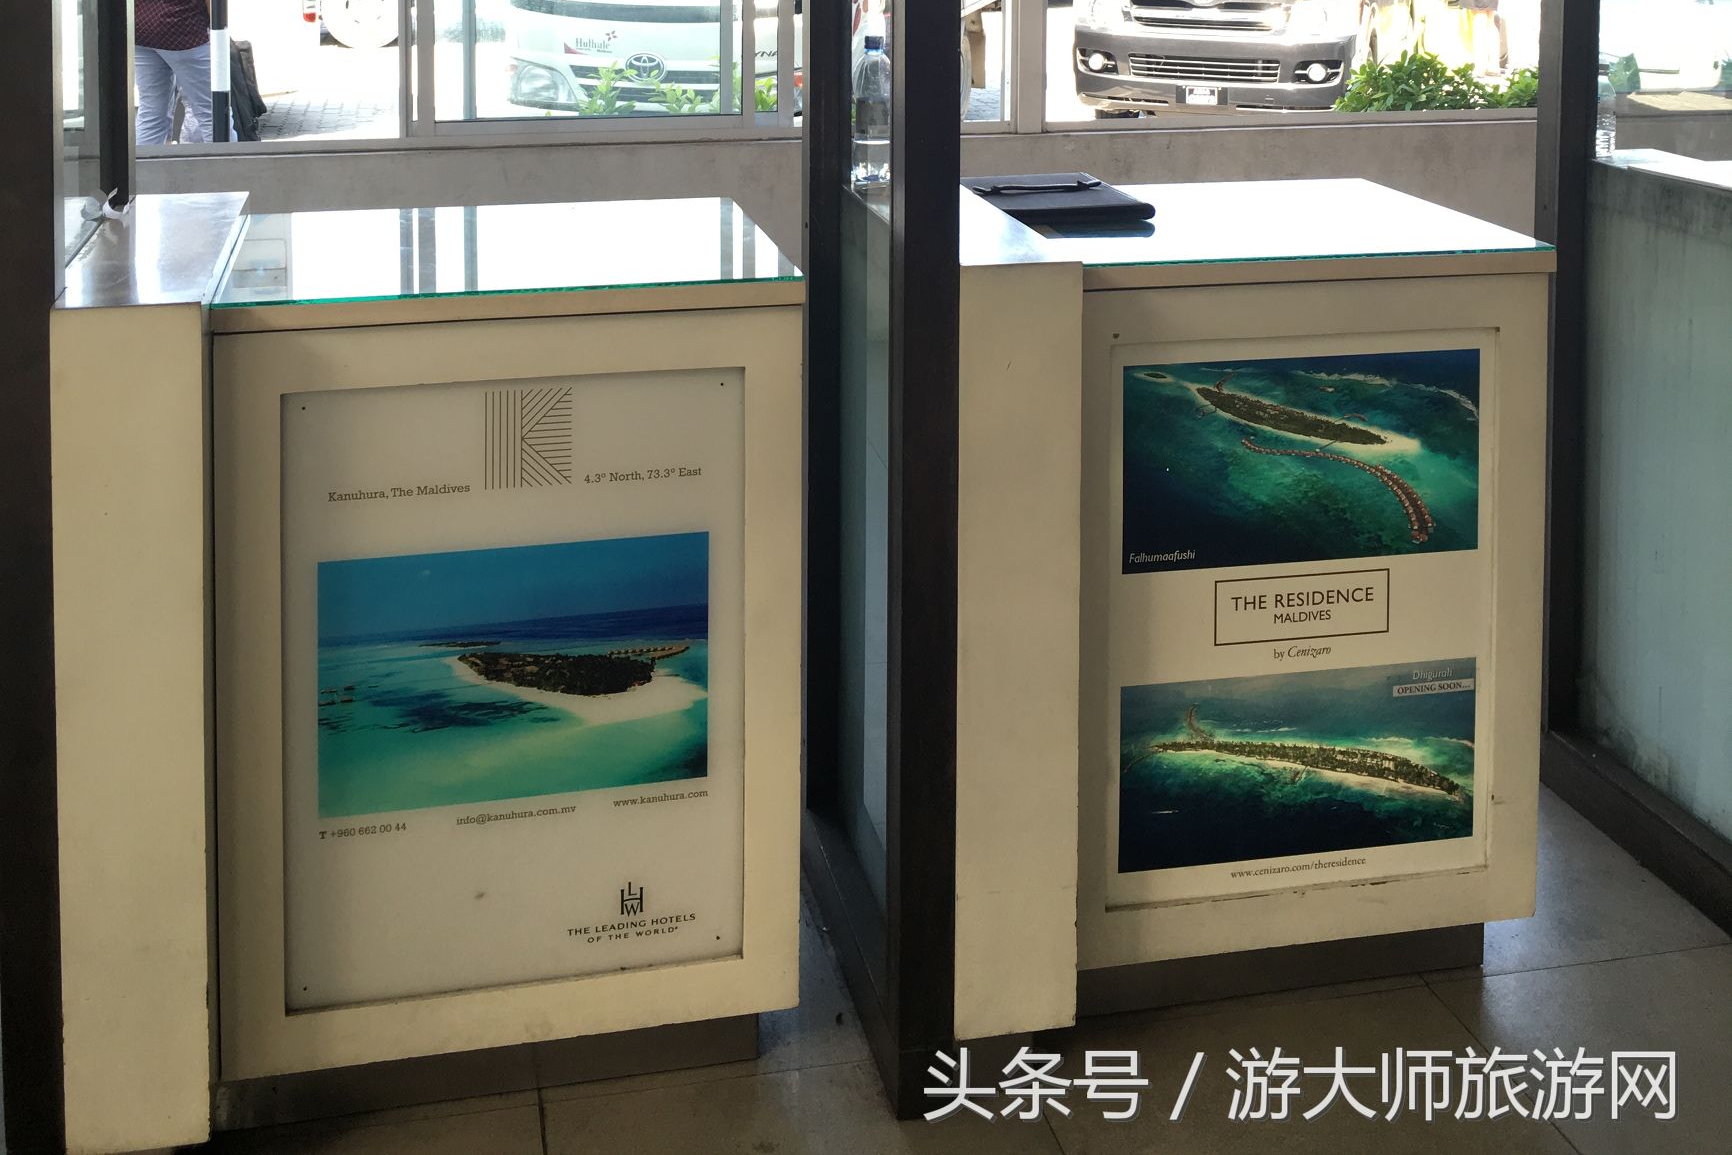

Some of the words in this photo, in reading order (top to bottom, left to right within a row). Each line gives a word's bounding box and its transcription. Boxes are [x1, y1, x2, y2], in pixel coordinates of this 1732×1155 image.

[609, 470, 645, 482] North,
[678, 467, 702, 477] East
[327, 490, 389, 503] Kanuhura,
[391, 487, 414, 498] The
[416, 484, 471, 496] Maldives
[1129, 549, 1196, 564] Falhumaafushi
[1231, 594, 1267, 612] THE
[1274, 586, 1375, 609] RESIDENCE
[1273, 609, 1332, 624] MALDIVES
[1273, 648, 1285, 661] by
[1287, 645, 1332, 659] Cenizaro
[1397, 684, 1436, 695] OPENING
[613, 789, 708, 808] www.kanuhura.com
[456, 805, 577, 826] info@kanuhura.com.mv
[318, 830, 328, 840] T
[330, 827, 356, 838] +960
[380, 823, 393, 834] 00
[395, 822, 407, 832] 44
[1230, 856, 1367, 879] www.cenizaro.com/theresidence
[567, 926, 591, 937] THE
[595, 919, 647, 934] LEADING
[651, 913, 697, 926] HOTELS
[587, 935, 602, 944] OF
[608, 932, 629, 941] THE
